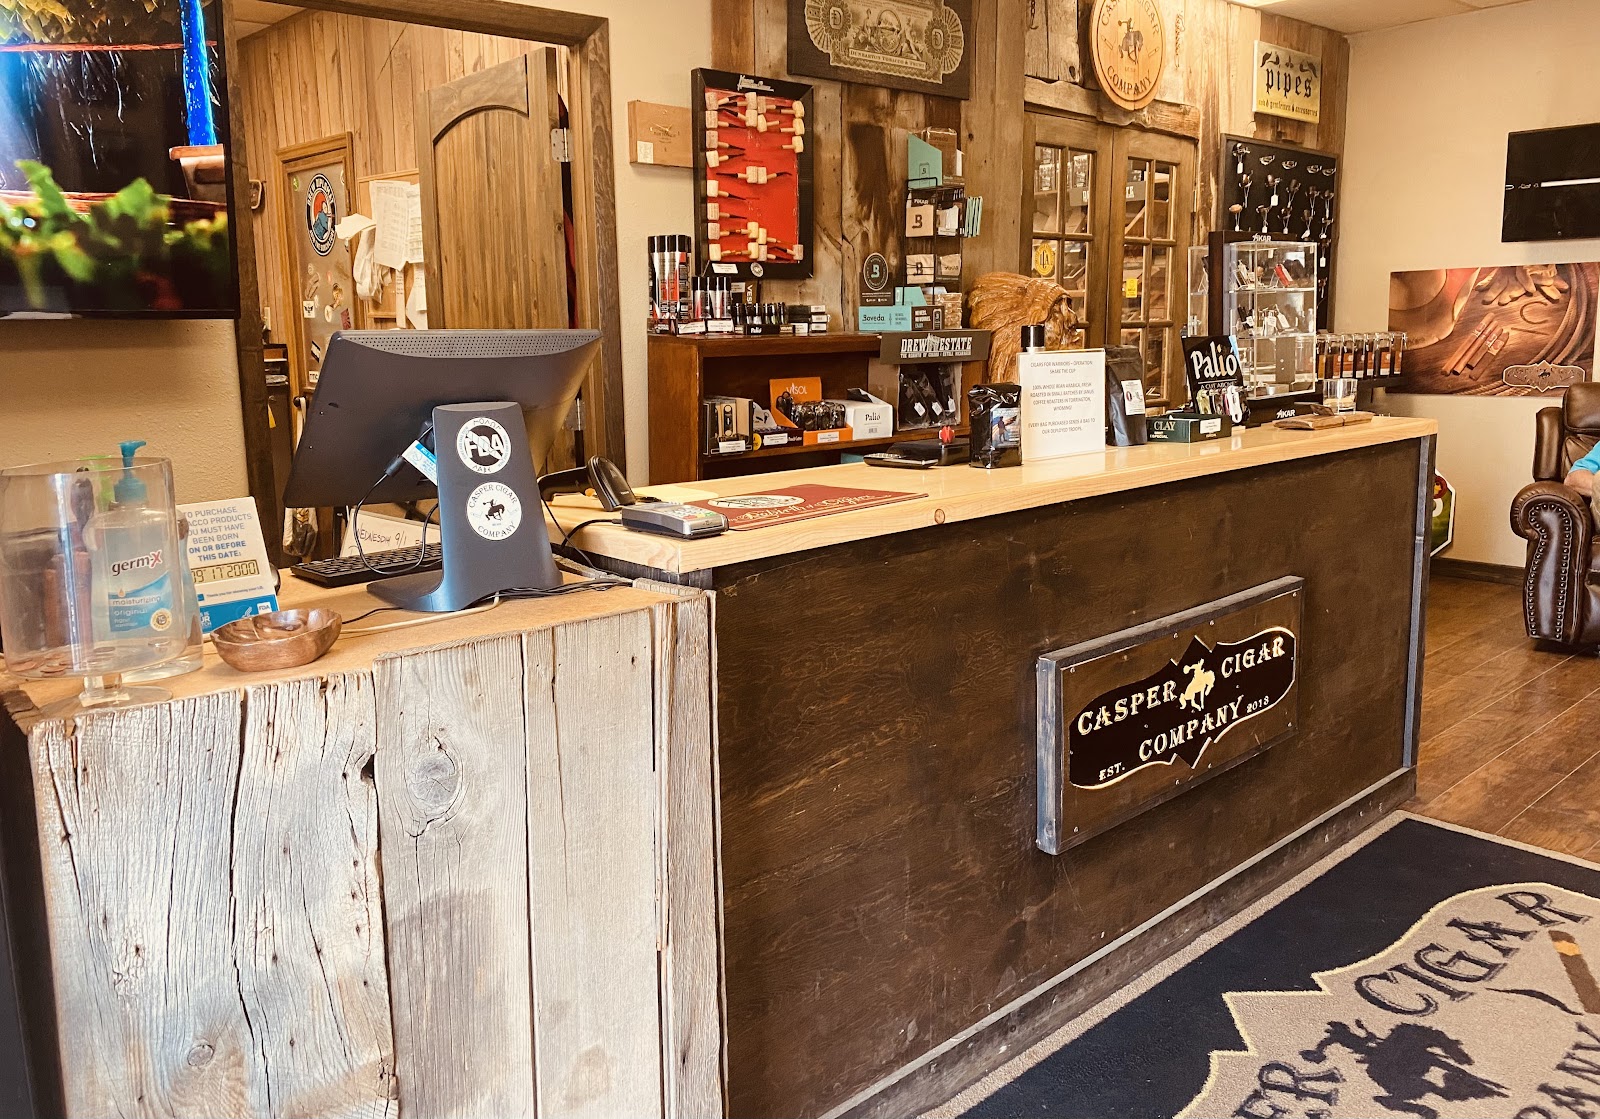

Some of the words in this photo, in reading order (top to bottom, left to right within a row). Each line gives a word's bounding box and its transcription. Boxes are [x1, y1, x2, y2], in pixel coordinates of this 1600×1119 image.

[1107, 66, 1152, 96] COMPANY
[1266, 68, 1313, 98] pipes
[862, 314, 885, 322] Boveda
[901, 338, 928, 352] DREW
[940, 337, 973, 350] ESTATE
[1190, 341, 1238, 380] Palio
[865, 413, 881, 421] Palio
[1154, 421, 1176, 431] CLAY
[465, 433, 504, 458] FDA
[469, 484, 494, 508] CASPER
[495, 484, 518, 504] CIGAR
[195, 506, 238, 517] PURCHASE
[189, 518, 209, 527] ACCO
[210, 513, 253, 524] PRODUCTS
[188, 528, 199, 537] OU
[200, 525, 222, 535] MUST
[224, 522, 245, 533] HAVE
[477, 521, 517, 538] COMPANY
[193, 535, 215, 545] BEEN
[216, 532, 239, 542] BORN
[188, 544, 201, 554] ON
[203, 543, 214, 552] OR
[215, 540, 247, 550] BEFORE
[198, 552, 217, 562] THIS
[218, 551, 242, 560] DATE:
[113, 595, 162, 606] moisturizing
[113, 608, 148, 617] original
[1077, 680, 1178, 735] CASPER
[1221, 636, 1286, 679] CIGAR
[1098, 762, 1126, 781] EST.
[1138, 694, 1245, 762] COMPANY
[1354, 890, 1593, 1018] CIGAR
